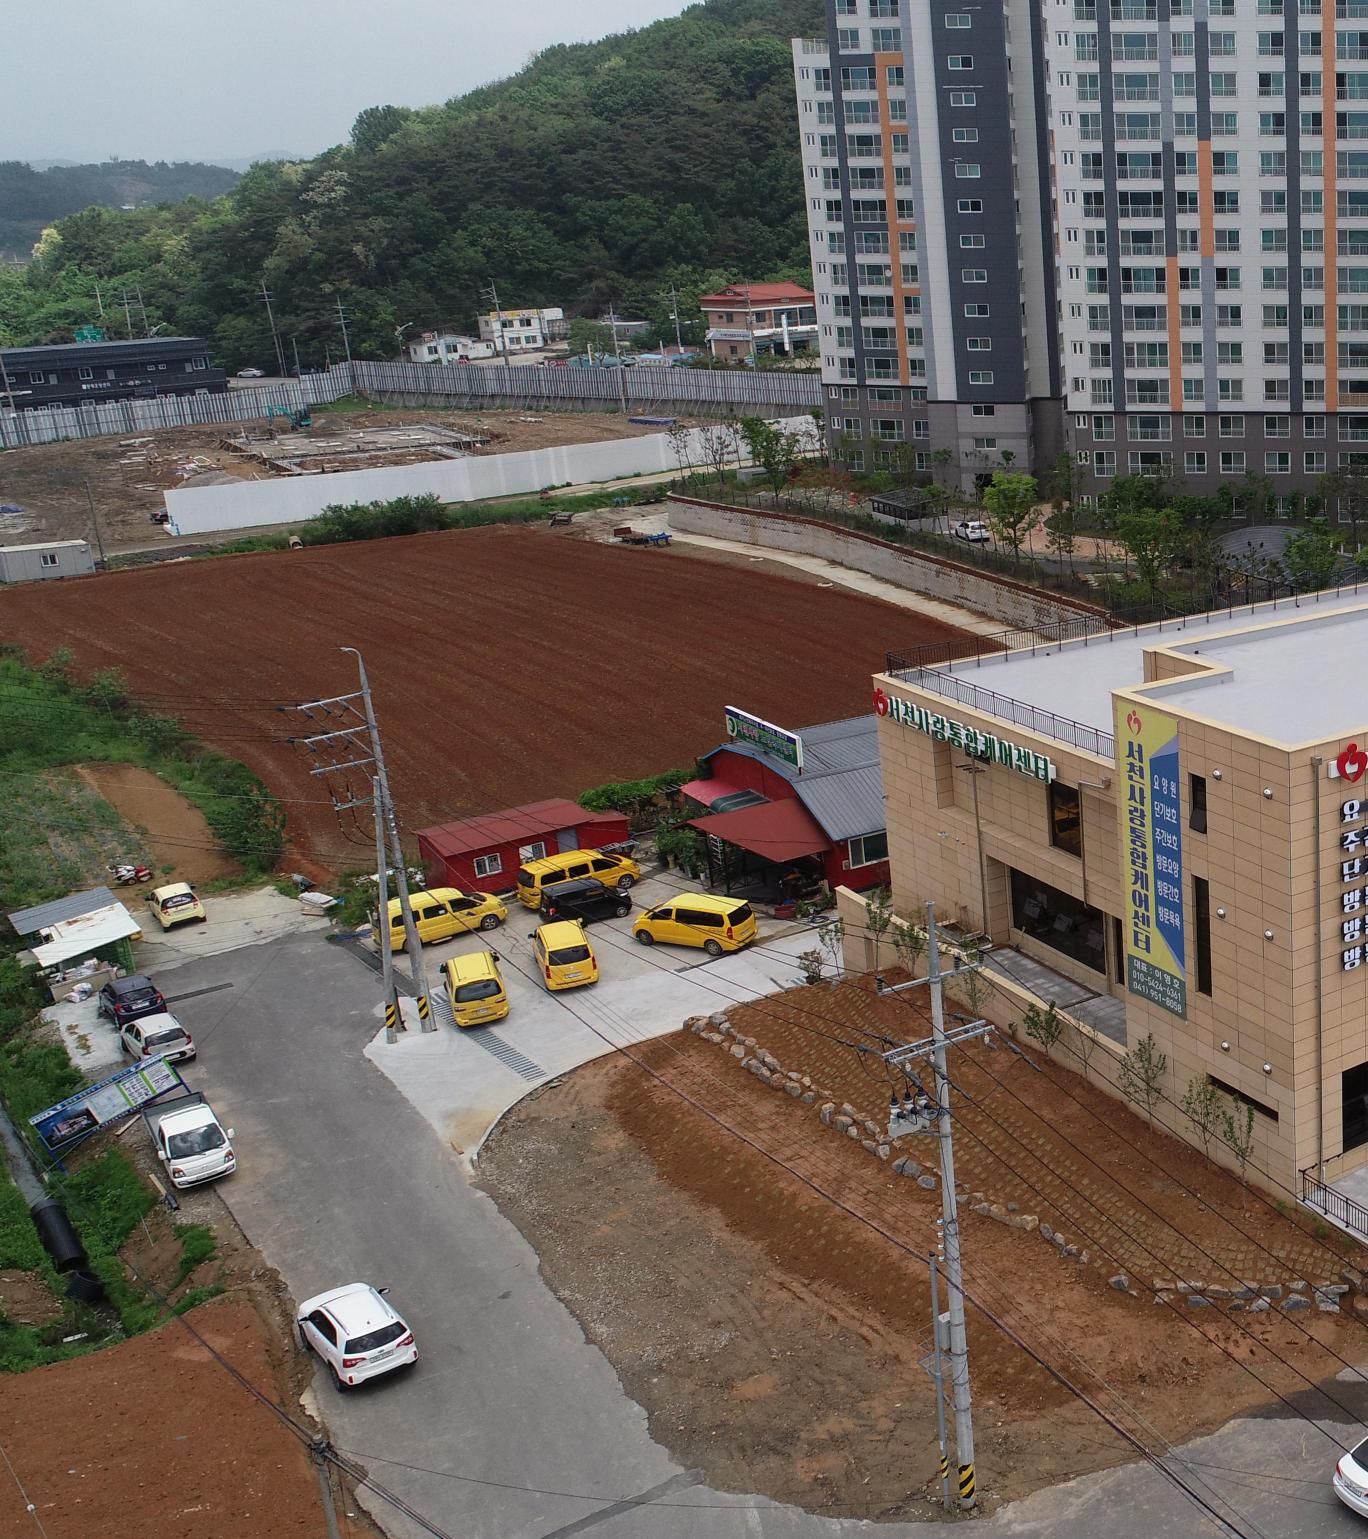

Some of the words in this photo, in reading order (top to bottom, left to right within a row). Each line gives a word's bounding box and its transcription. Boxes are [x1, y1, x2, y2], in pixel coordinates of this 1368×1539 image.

[887, 695, 1053, 785] 서천사랑통합케어센터
[1153, 800, 1178, 824] 단기보호
[1125, 739, 1152, 955] 서천사랑통합케어센터
[1154, 827, 1179, 851] 주간보호
[1155, 853, 1180, 878] 방문요양
[1156, 878, 1181, 904] 방문간호
[1157, 905, 1181, 930] 방문목욕
